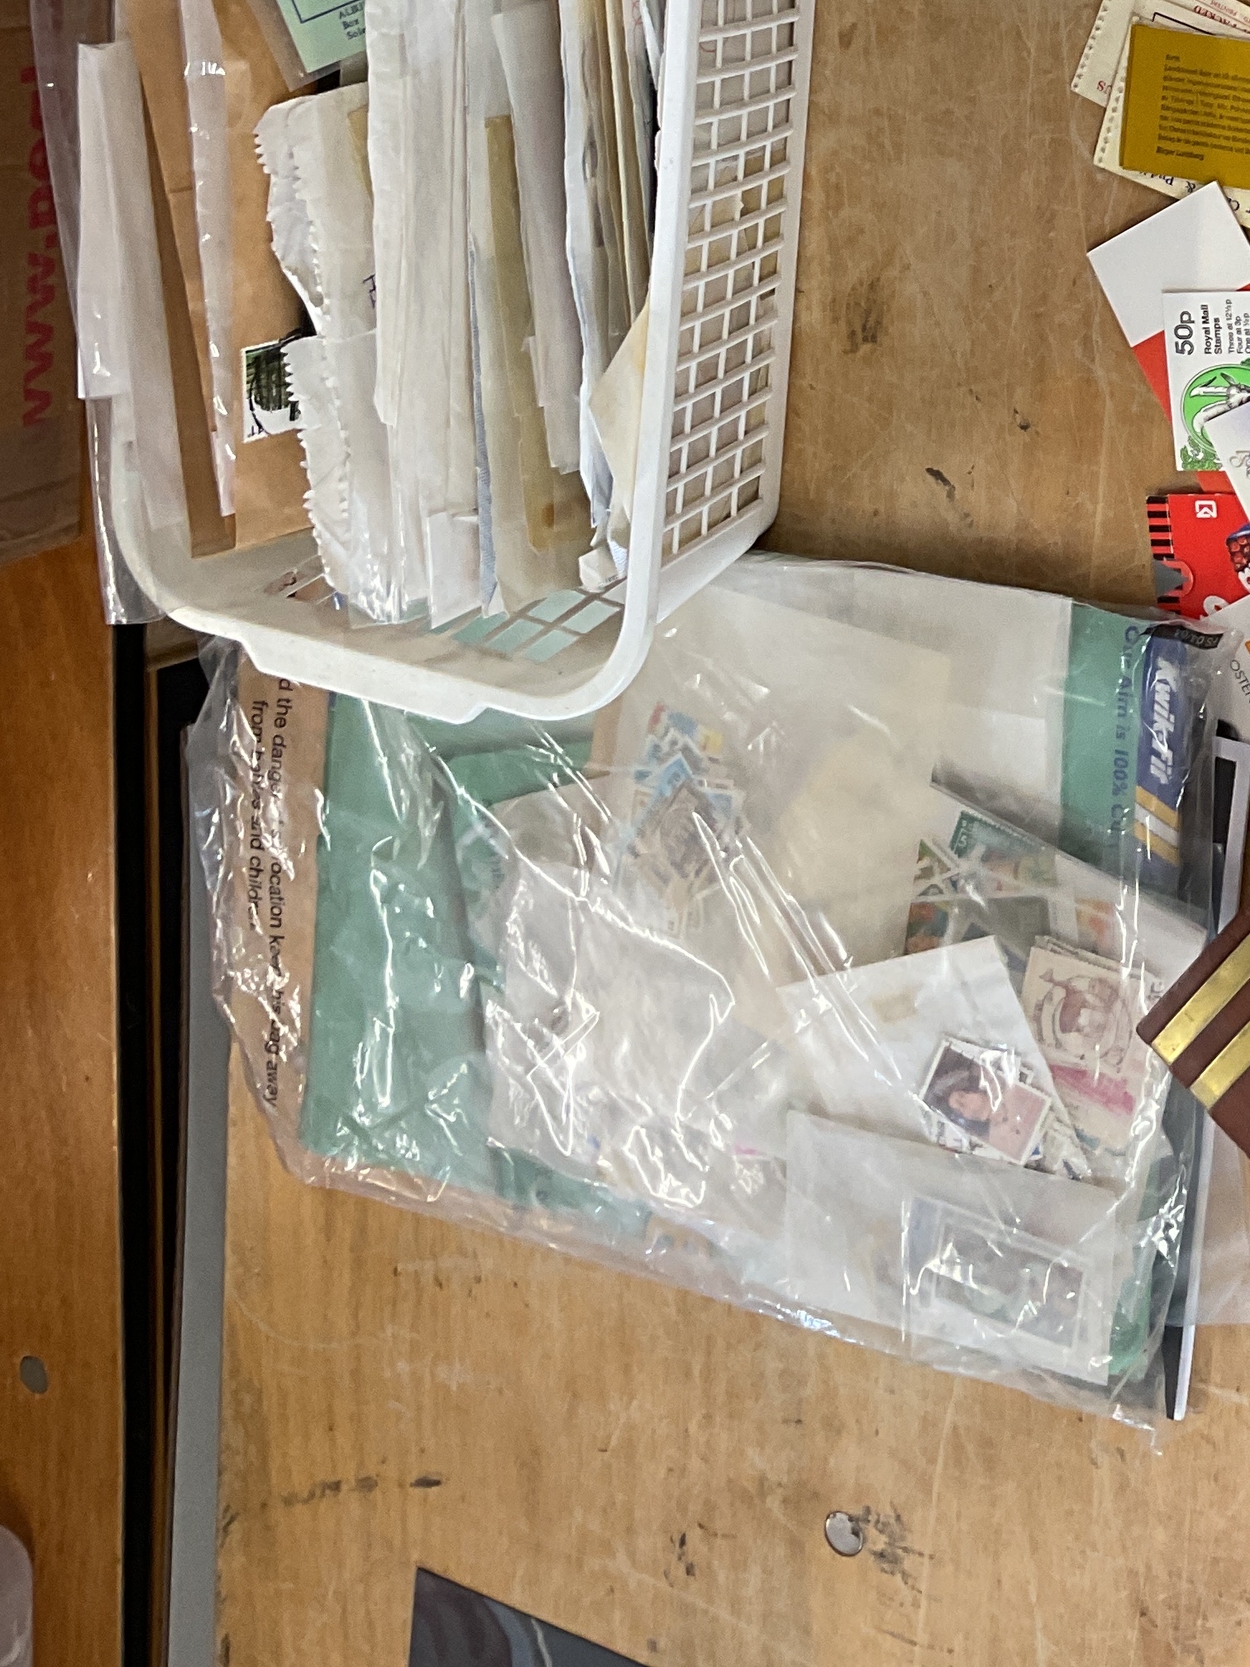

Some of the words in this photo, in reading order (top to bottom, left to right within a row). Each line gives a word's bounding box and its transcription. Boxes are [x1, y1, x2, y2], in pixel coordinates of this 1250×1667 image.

[1175, 310, 1196, 356] 50p
[1214, 317, 1223, 355] Stamps
[1236, 315, 1243, 326] 3p
[1204, 331, 1212, 355] Royal
[278, 696, 292, 724] the
[262, 1060, 279, 1108] away
